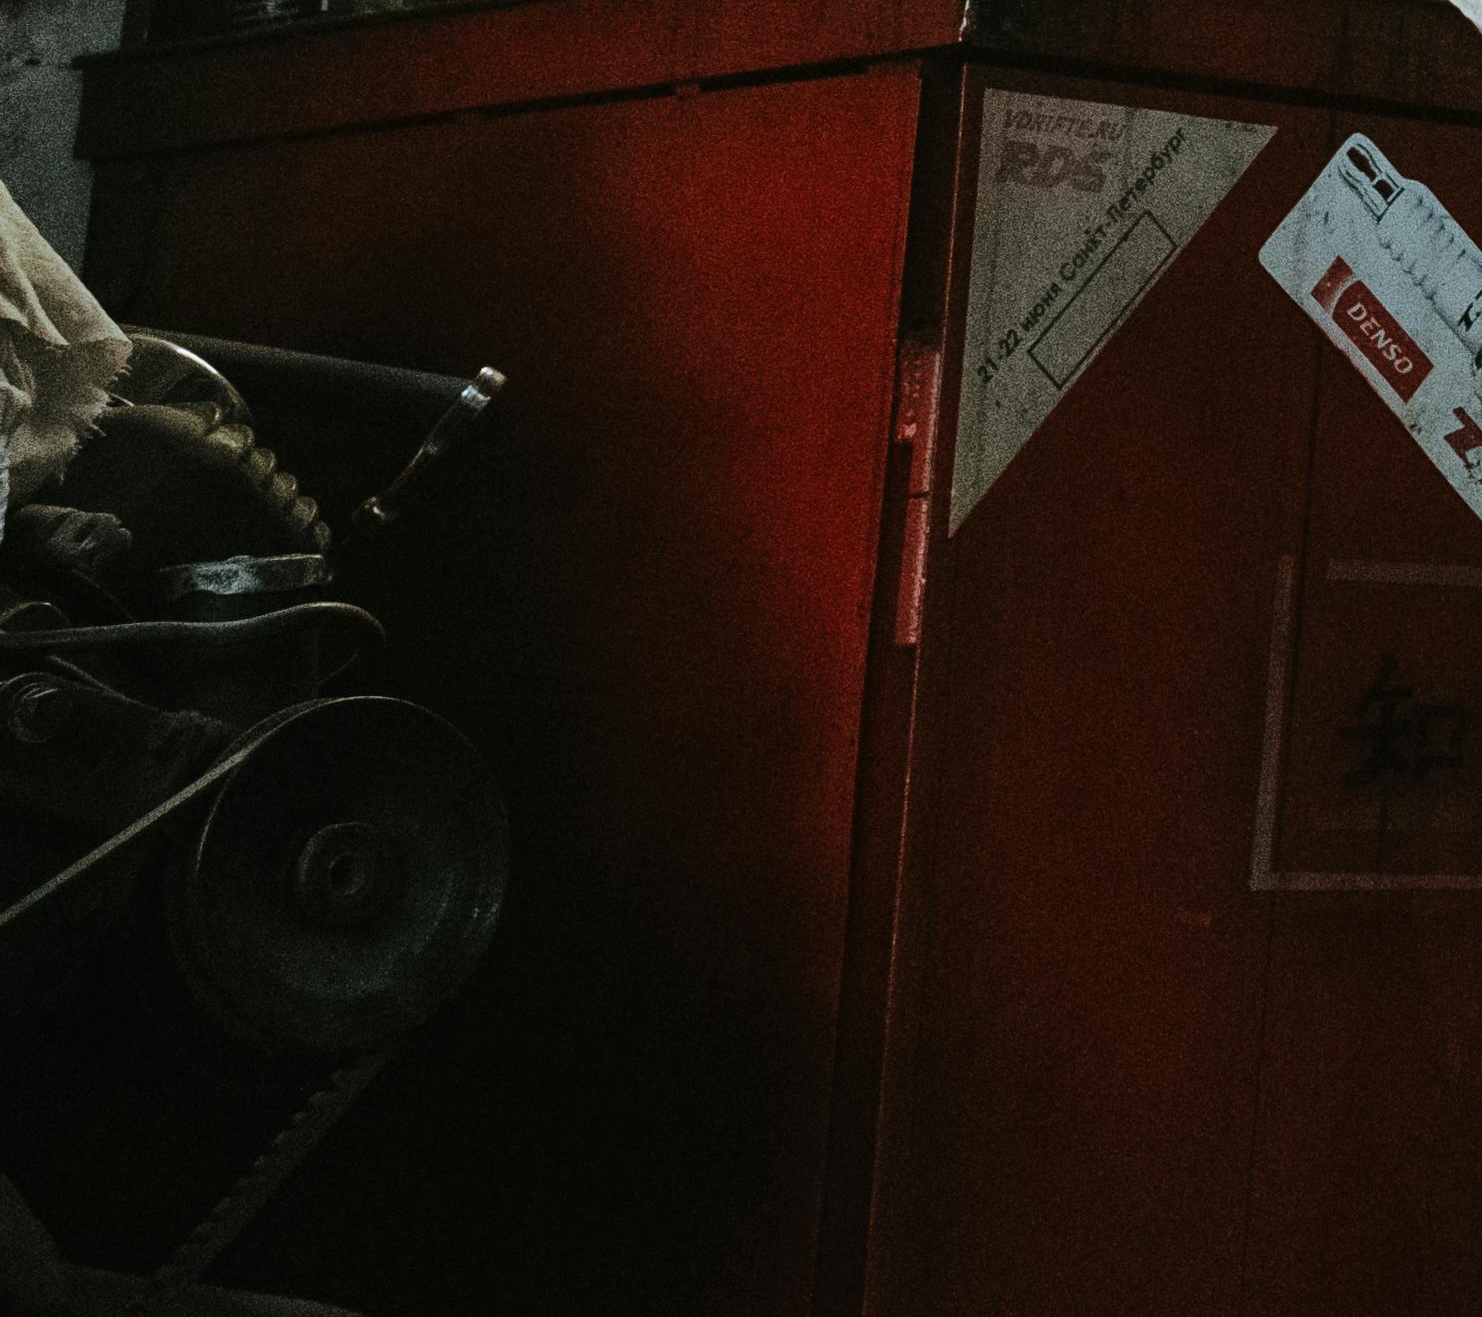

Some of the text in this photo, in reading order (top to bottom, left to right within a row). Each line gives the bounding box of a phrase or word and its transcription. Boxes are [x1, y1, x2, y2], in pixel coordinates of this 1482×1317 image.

[1021, 283, 1063, 335] июня
[1058, 126, 1187, 284] Санкт-Петербург
[1346, 301, 1414, 376] DENSO
